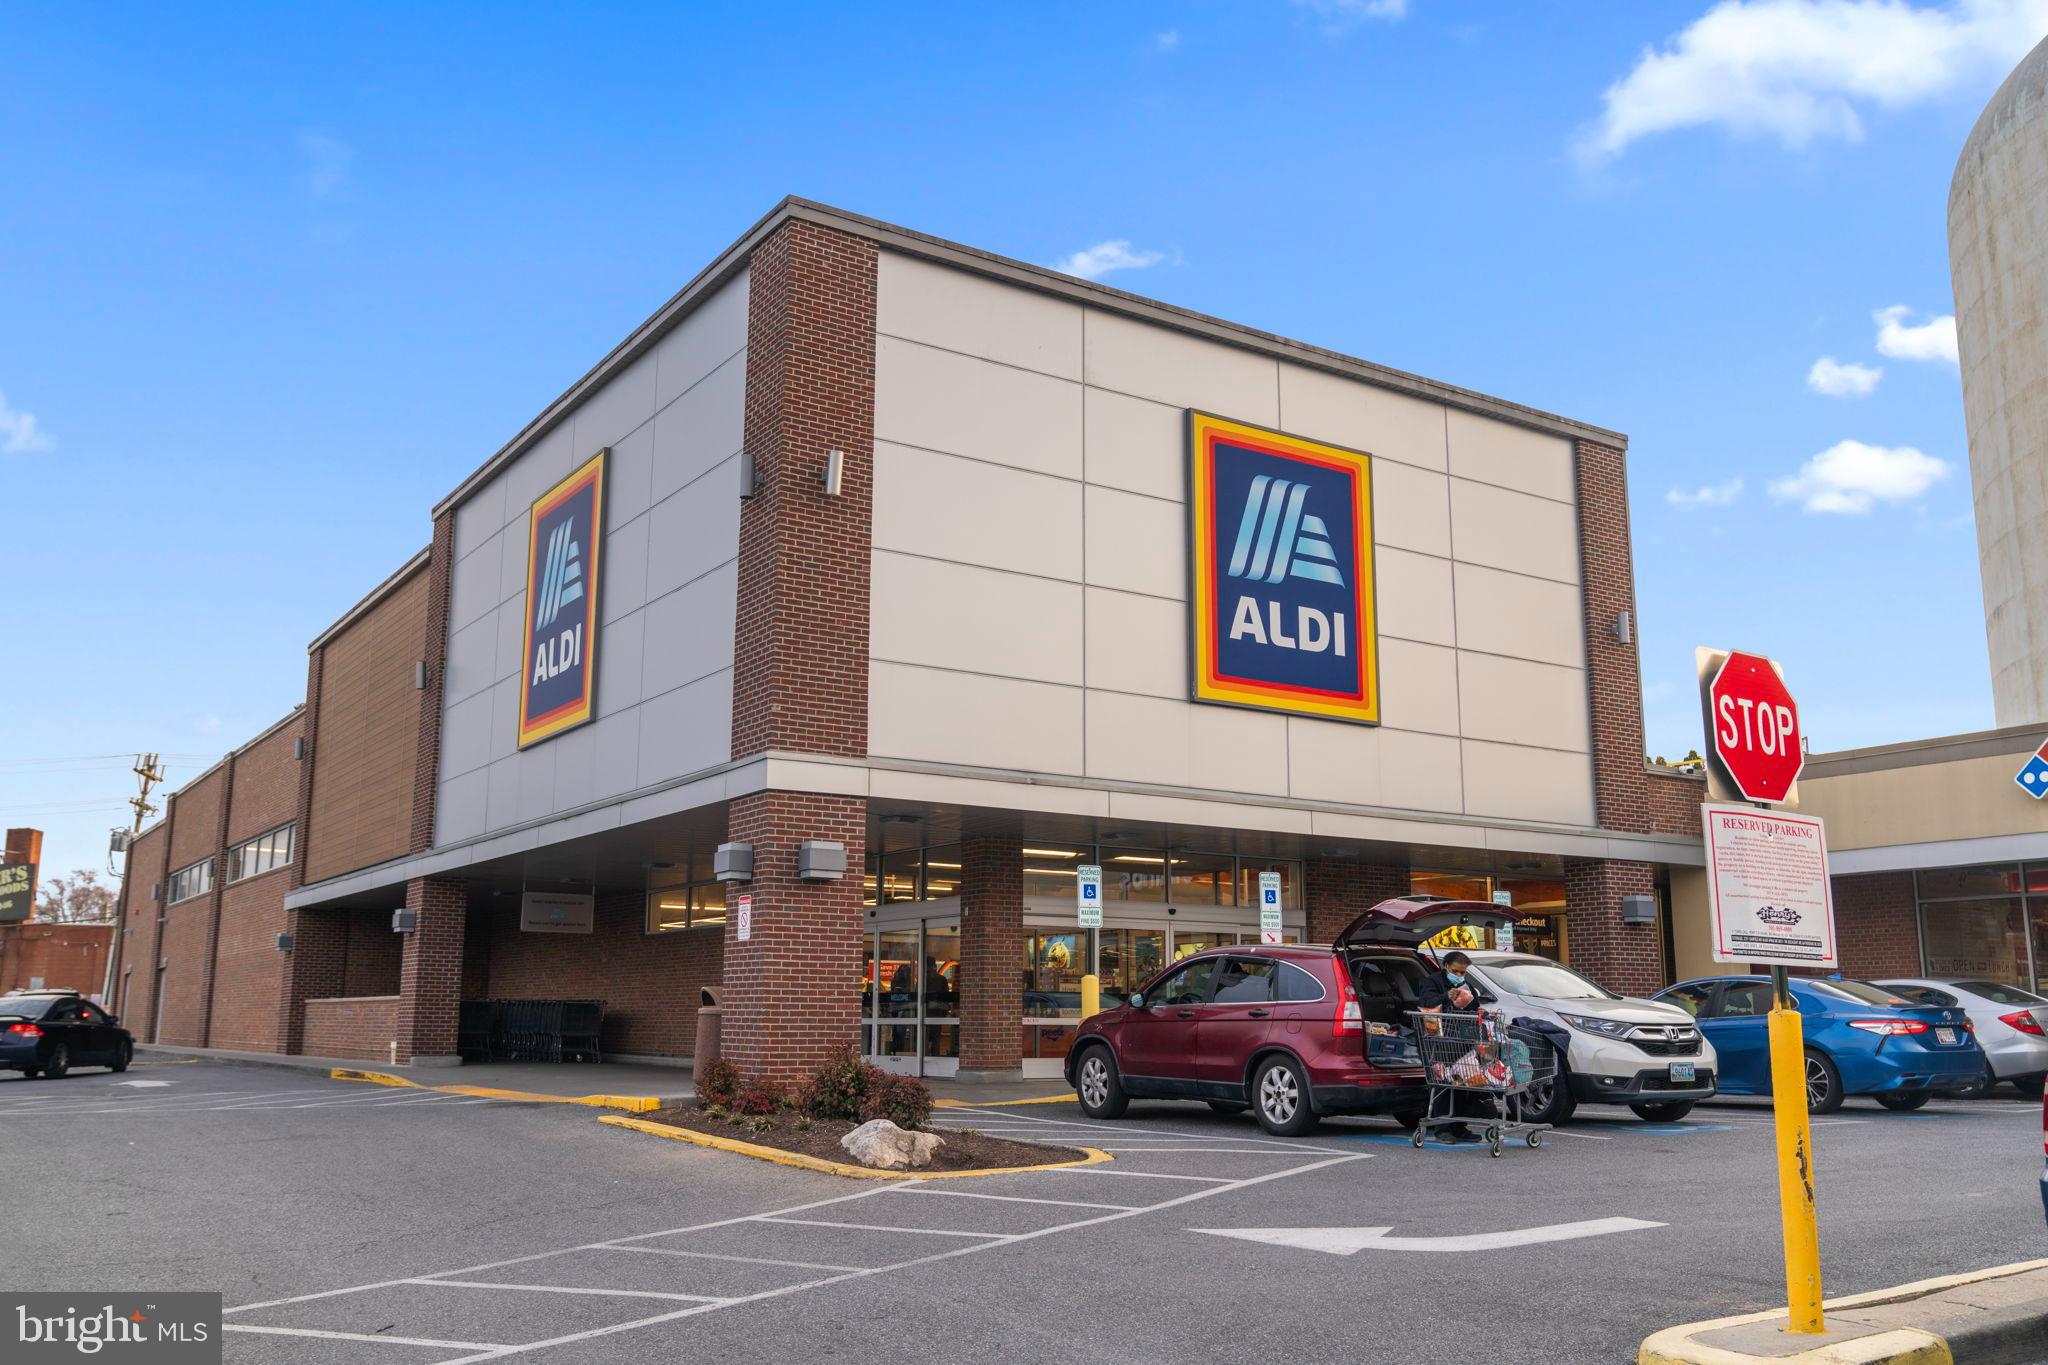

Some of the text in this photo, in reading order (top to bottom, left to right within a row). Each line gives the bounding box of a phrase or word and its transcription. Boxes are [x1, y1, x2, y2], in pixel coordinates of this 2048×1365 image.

[532, 622, 582, 687] ALDI
[1229, 595, 1346, 657] ALDI
[1718, 694, 1794, 757] STOP
[1722, 817, 1813, 840] RESERVED PARKING
[1952, 959, 1975, 973] OPEN
[1988, 959, 2011, 974] LUNCH
